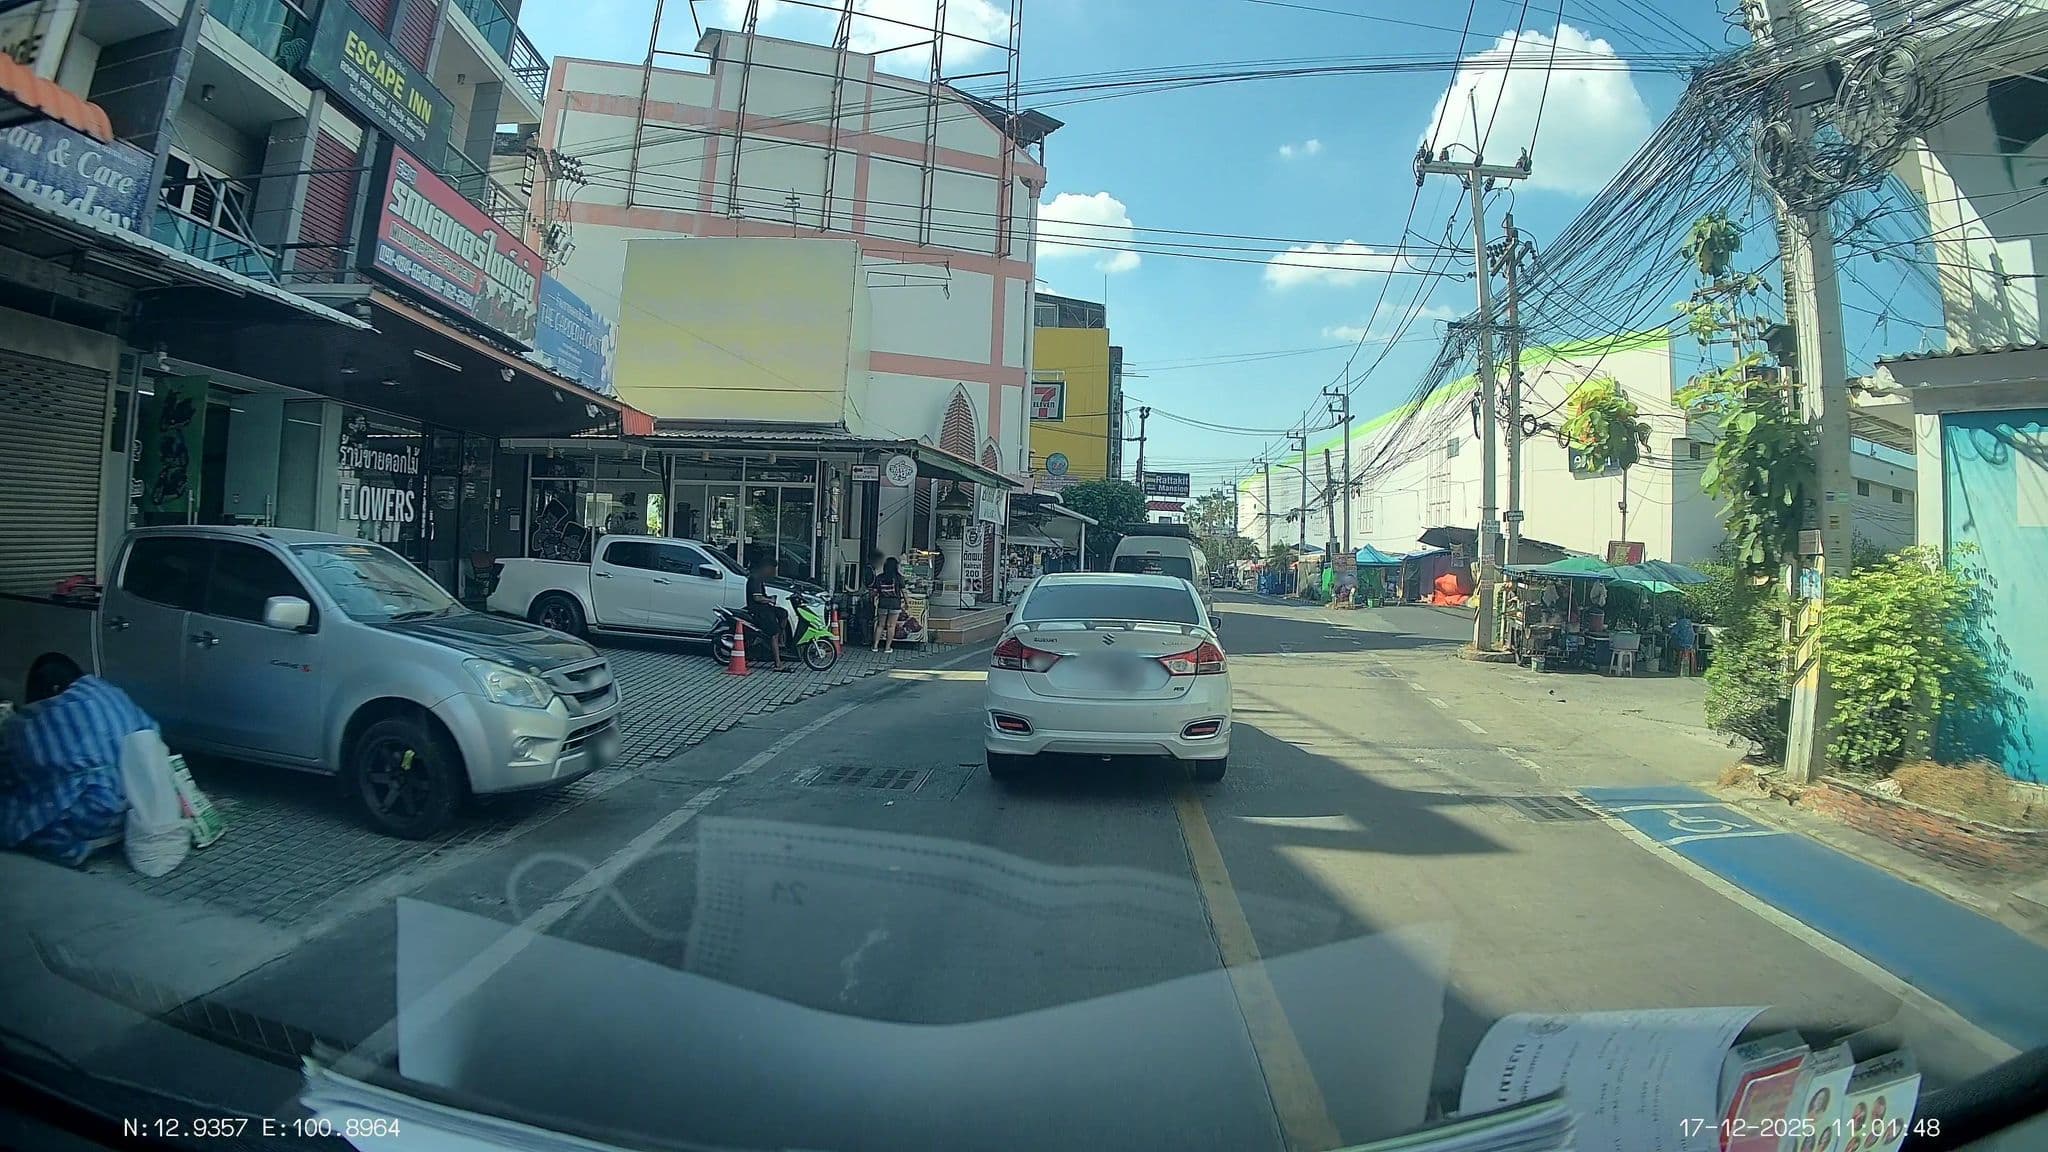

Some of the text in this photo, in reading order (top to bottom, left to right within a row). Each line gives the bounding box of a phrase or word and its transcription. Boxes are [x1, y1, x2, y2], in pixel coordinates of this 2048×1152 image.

[344, 30, 405, 100] ESCAPE
[408, 87, 433, 125] INN
[48, 138, 72, 168] &
[77, 150, 136, 194] Care
[1034, 386, 1057, 417] 7
[339, 433, 420, 476] ร้านขายดอกไม้
[1156, 475, 1189, 486] Rattakit
[1158, 484, 1189, 493] Mansion
[339, 483, 415, 523] FLOWERS
[965, 569, 980, 578] 200
